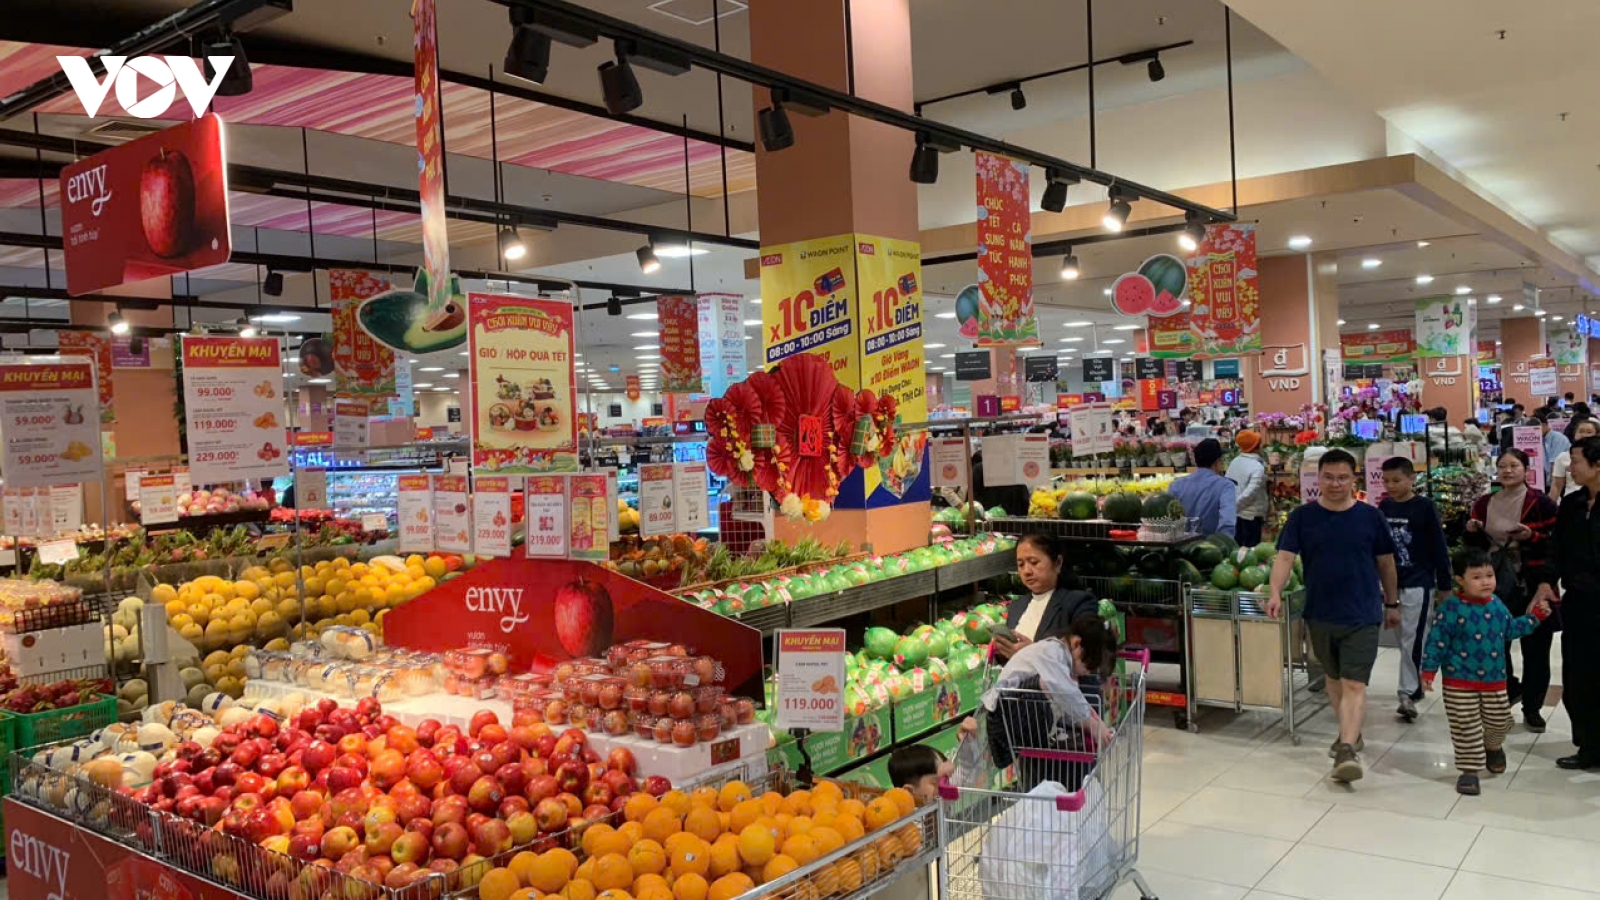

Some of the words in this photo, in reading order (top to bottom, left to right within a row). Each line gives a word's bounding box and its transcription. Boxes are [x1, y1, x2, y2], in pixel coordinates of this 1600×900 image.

[68, 165, 112, 216] envy
[985, 233, 1005, 246] SUNG
[829, 246, 849, 255] POINT
[1216, 291, 1230, 302] VUI
[810, 294, 847, 328] ĐIỂM
[895, 296, 919, 325] ĐIỂM
[528, 316, 541, 328] VUI
[769, 342, 795, 359] 08:00
[801, 332, 824, 348] 10:00
[826, 324, 849, 338] Sáng
[867, 336, 885, 351] 08:00
[889, 329, 904, 343] 10:00
[905, 326, 920, 338] Sáng
[190, 341, 246, 357] KHUYẾN
[249, 346, 272, 359] MẠI
[506, 348, 527, 361] HỘP
[4, 368, 58, 382] KHUYẾN
[61, 370, 85, 381] MẠI
[1433, 377, 1456, 386] VND
[1268, 379, 1301, 392] VND
[1161, 393, 1169, 404] 5
[1224, 391, 1233, 403] 6
[984, 399, 990, 413] 1
[465, 586, 529, 633] envy
[784, 634, 820, 645] KHUYẾN
[822, 637, 839, 646] MẠI
